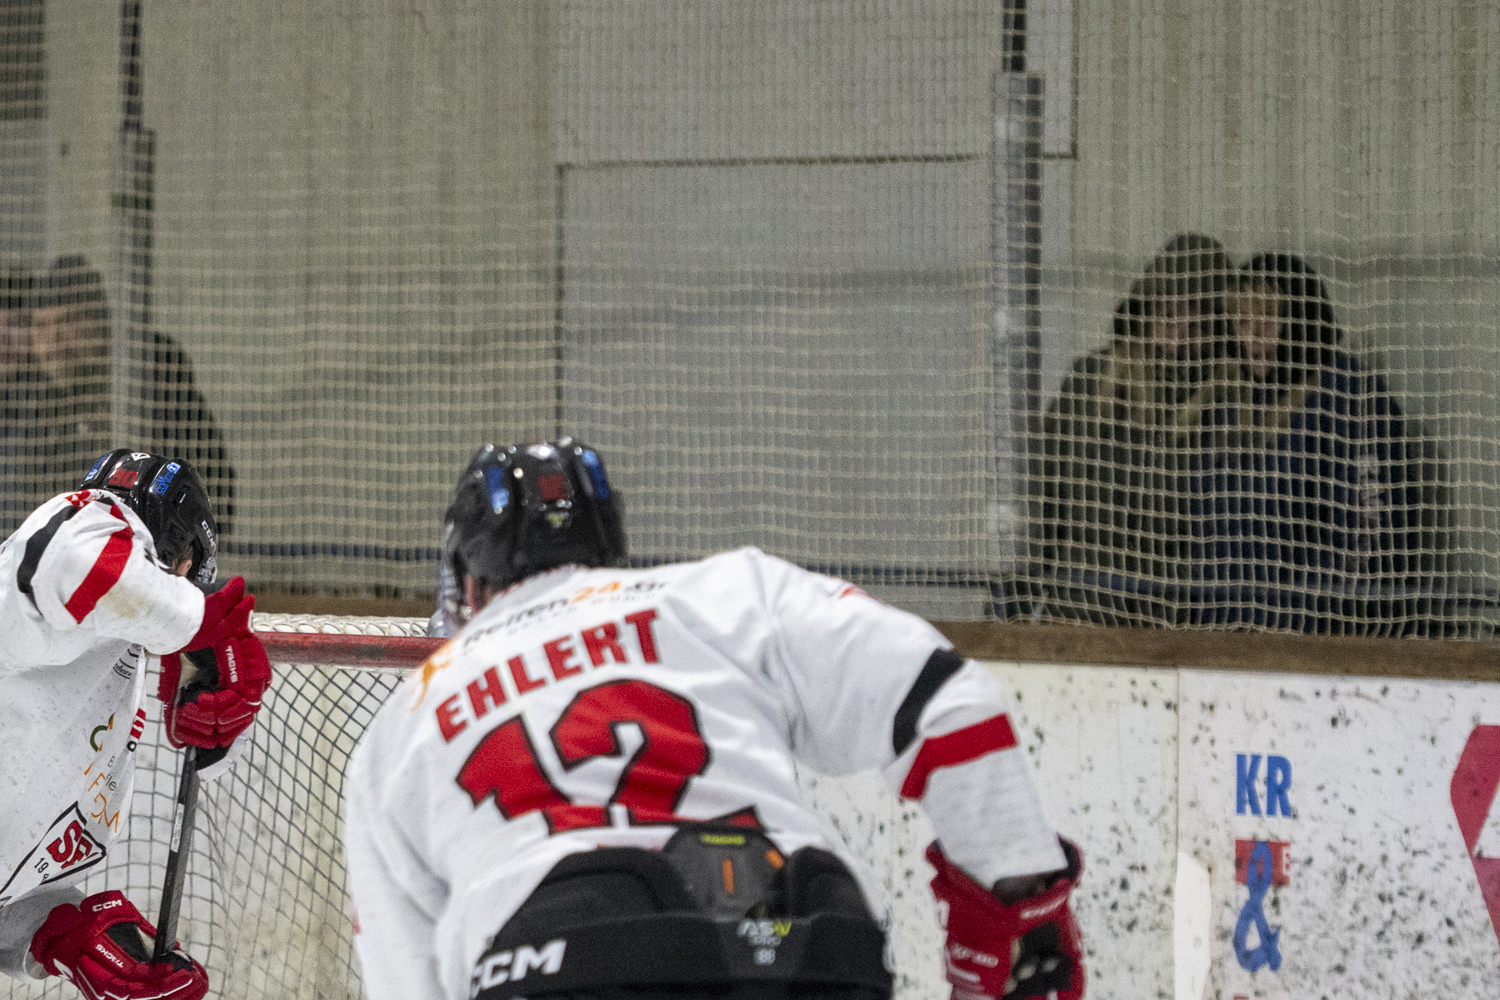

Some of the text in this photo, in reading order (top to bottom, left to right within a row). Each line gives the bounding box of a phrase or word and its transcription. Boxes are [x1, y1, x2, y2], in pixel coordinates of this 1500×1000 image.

[225, 645, 239, 683] TACKS
[435, 608, 661, 744] EHLERT
[455, 678, 766, 836] 12
[1236, 753, 1293, 818] KR
[92, 899, 123, 912] CCM
